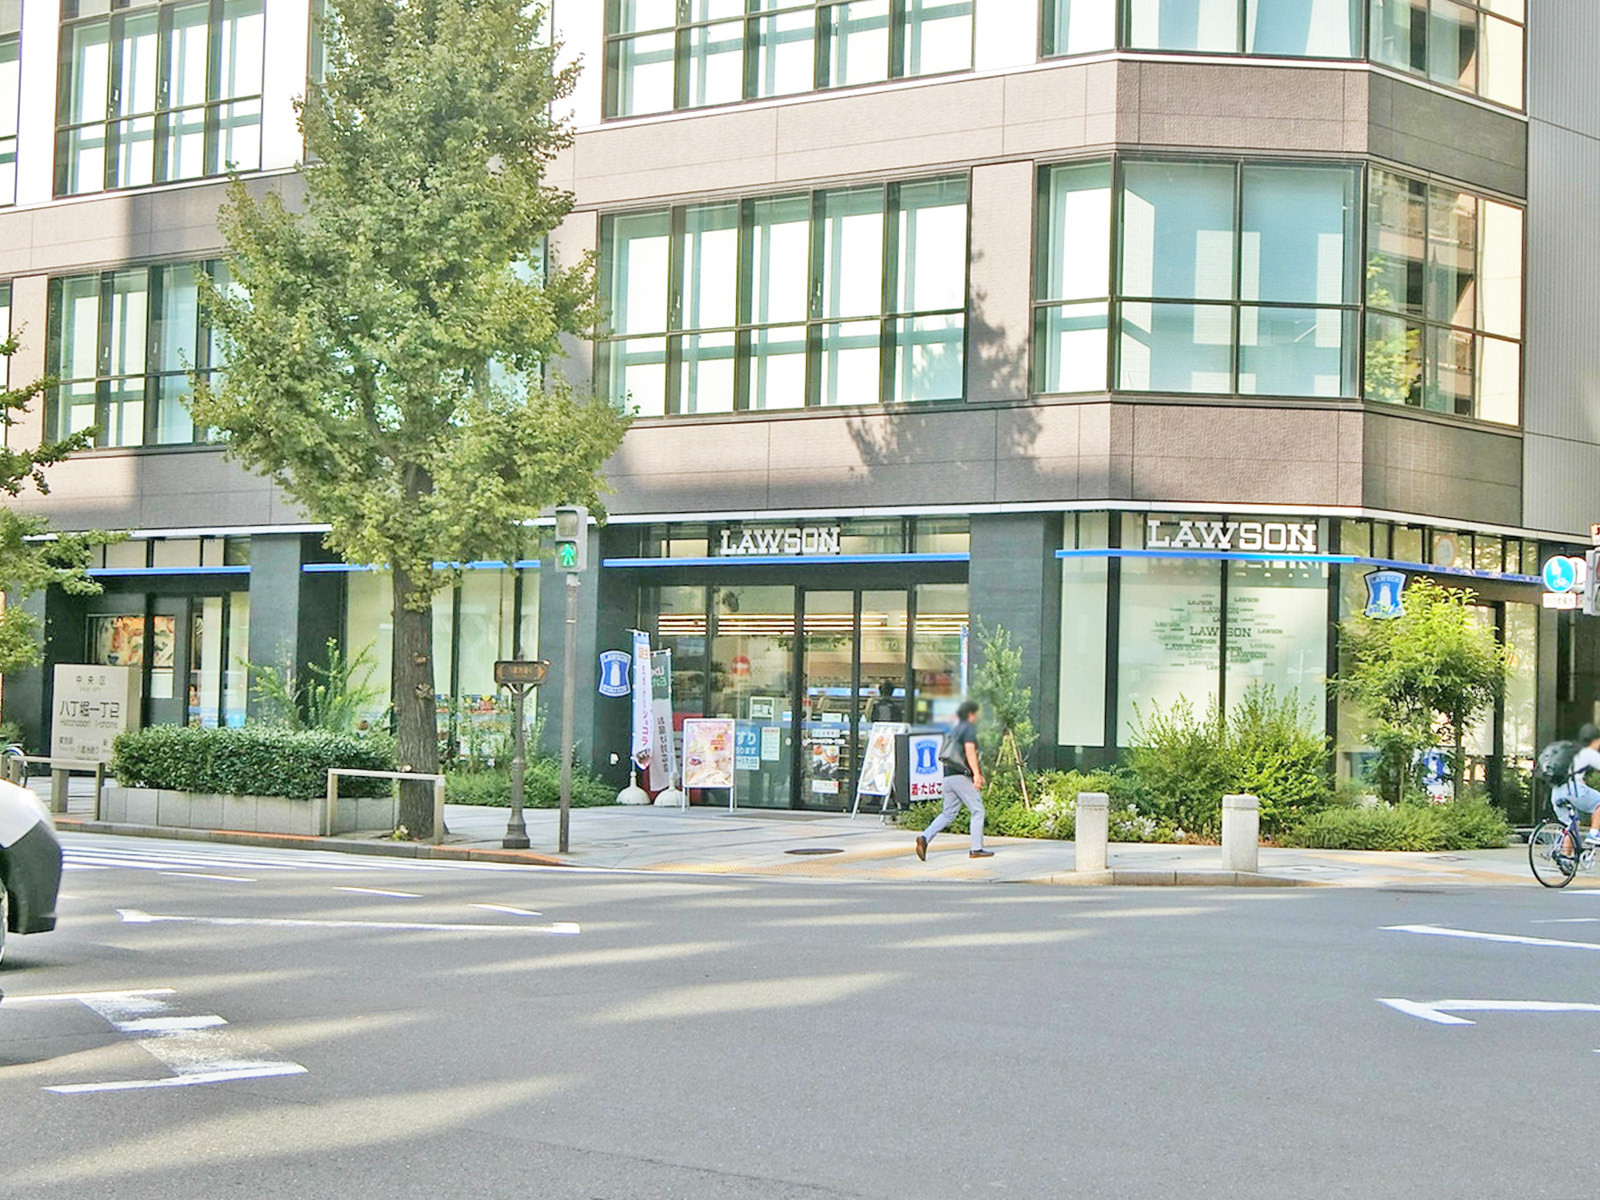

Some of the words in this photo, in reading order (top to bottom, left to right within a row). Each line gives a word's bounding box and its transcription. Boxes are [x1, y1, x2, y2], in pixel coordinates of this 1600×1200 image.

[720, 526, 840, 554] LAWSON
[1147, 520, 1317, 552] LAWSON
[1189, 626, 1252, 638] LAWSON
[1164, 643, 1203, 651] LAWSON
[1230, 651, 1268, 659] LAWSON
[76, 675, 106, 686] 中央区
[59, 700, 120, 718] 八丁堀一丁目
[736, 731, 757, 745] すり
